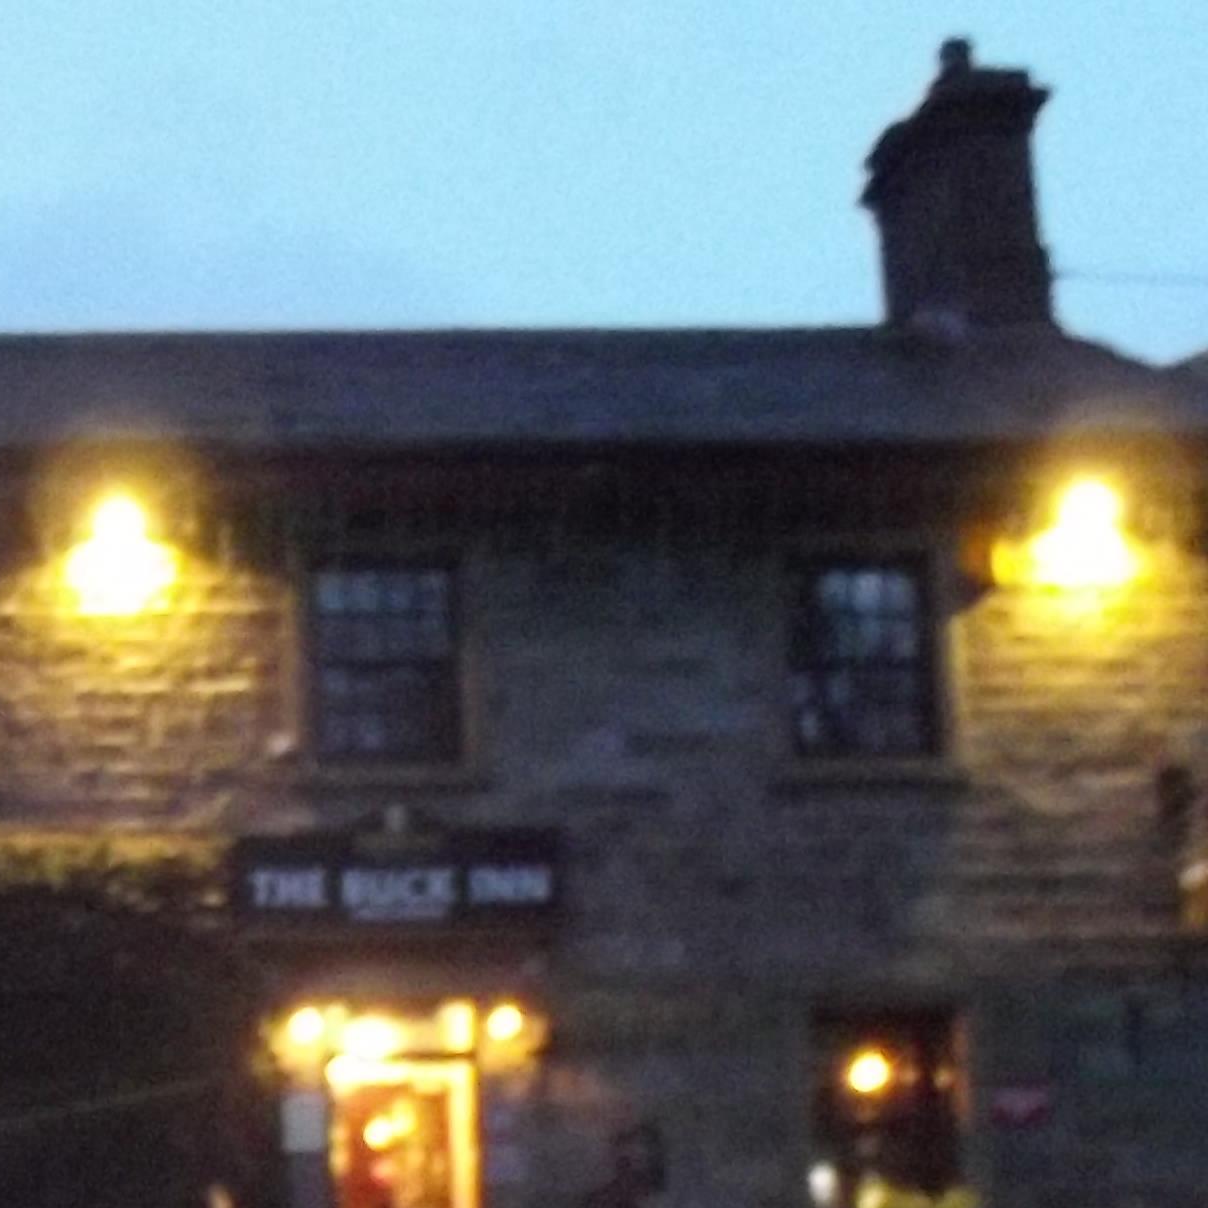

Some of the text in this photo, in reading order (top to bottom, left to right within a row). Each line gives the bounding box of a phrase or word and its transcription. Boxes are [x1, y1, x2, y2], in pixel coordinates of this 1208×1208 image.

[252, 866, 551, 907] THE BUCK INN
